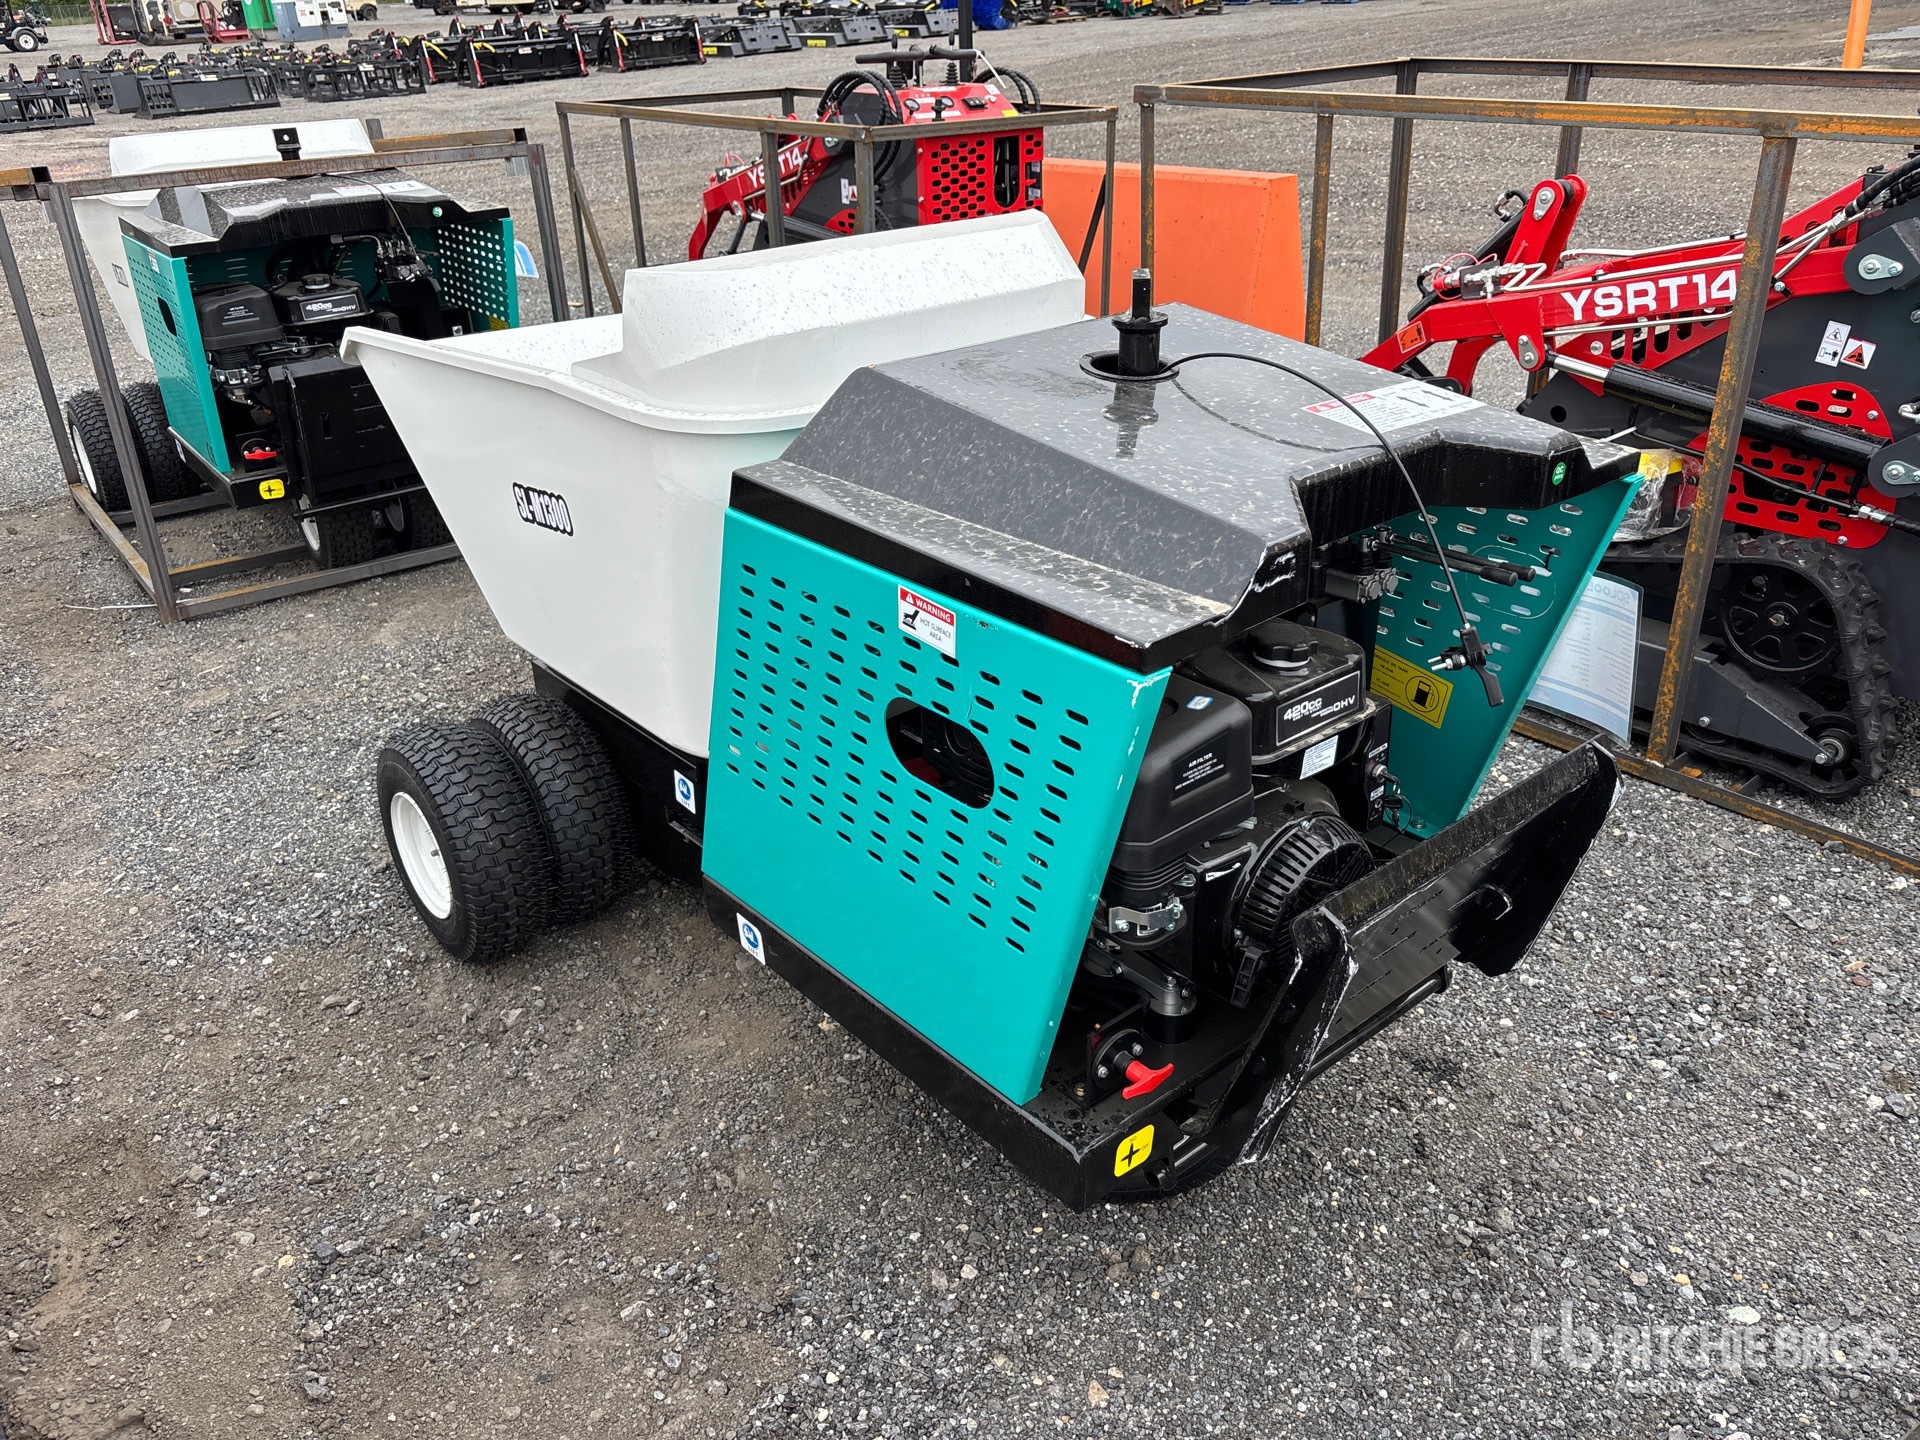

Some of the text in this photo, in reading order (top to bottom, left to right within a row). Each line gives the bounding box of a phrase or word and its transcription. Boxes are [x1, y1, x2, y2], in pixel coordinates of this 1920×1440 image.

[746, 147, 802, 189] YST14
[1560, 269, 1737, 321] YSRT14
[513, 483, 573, 536] SL-M1300
[915, 597, 952, 623] WARNING
[919, 617, 952, 639] HOT SURFACE
[929, 631, 942, 642] AREA
[1397, 665, 1409, 674] TANK
[1283, 697, 1323, 720] 420cc
[1333, 694, 1356, 712] OHV
[1188, 752, 1213, 768] AIR FILTER
[681, 798, 691, 808] LIFT
[747, 944, 759, 957] LIFT
